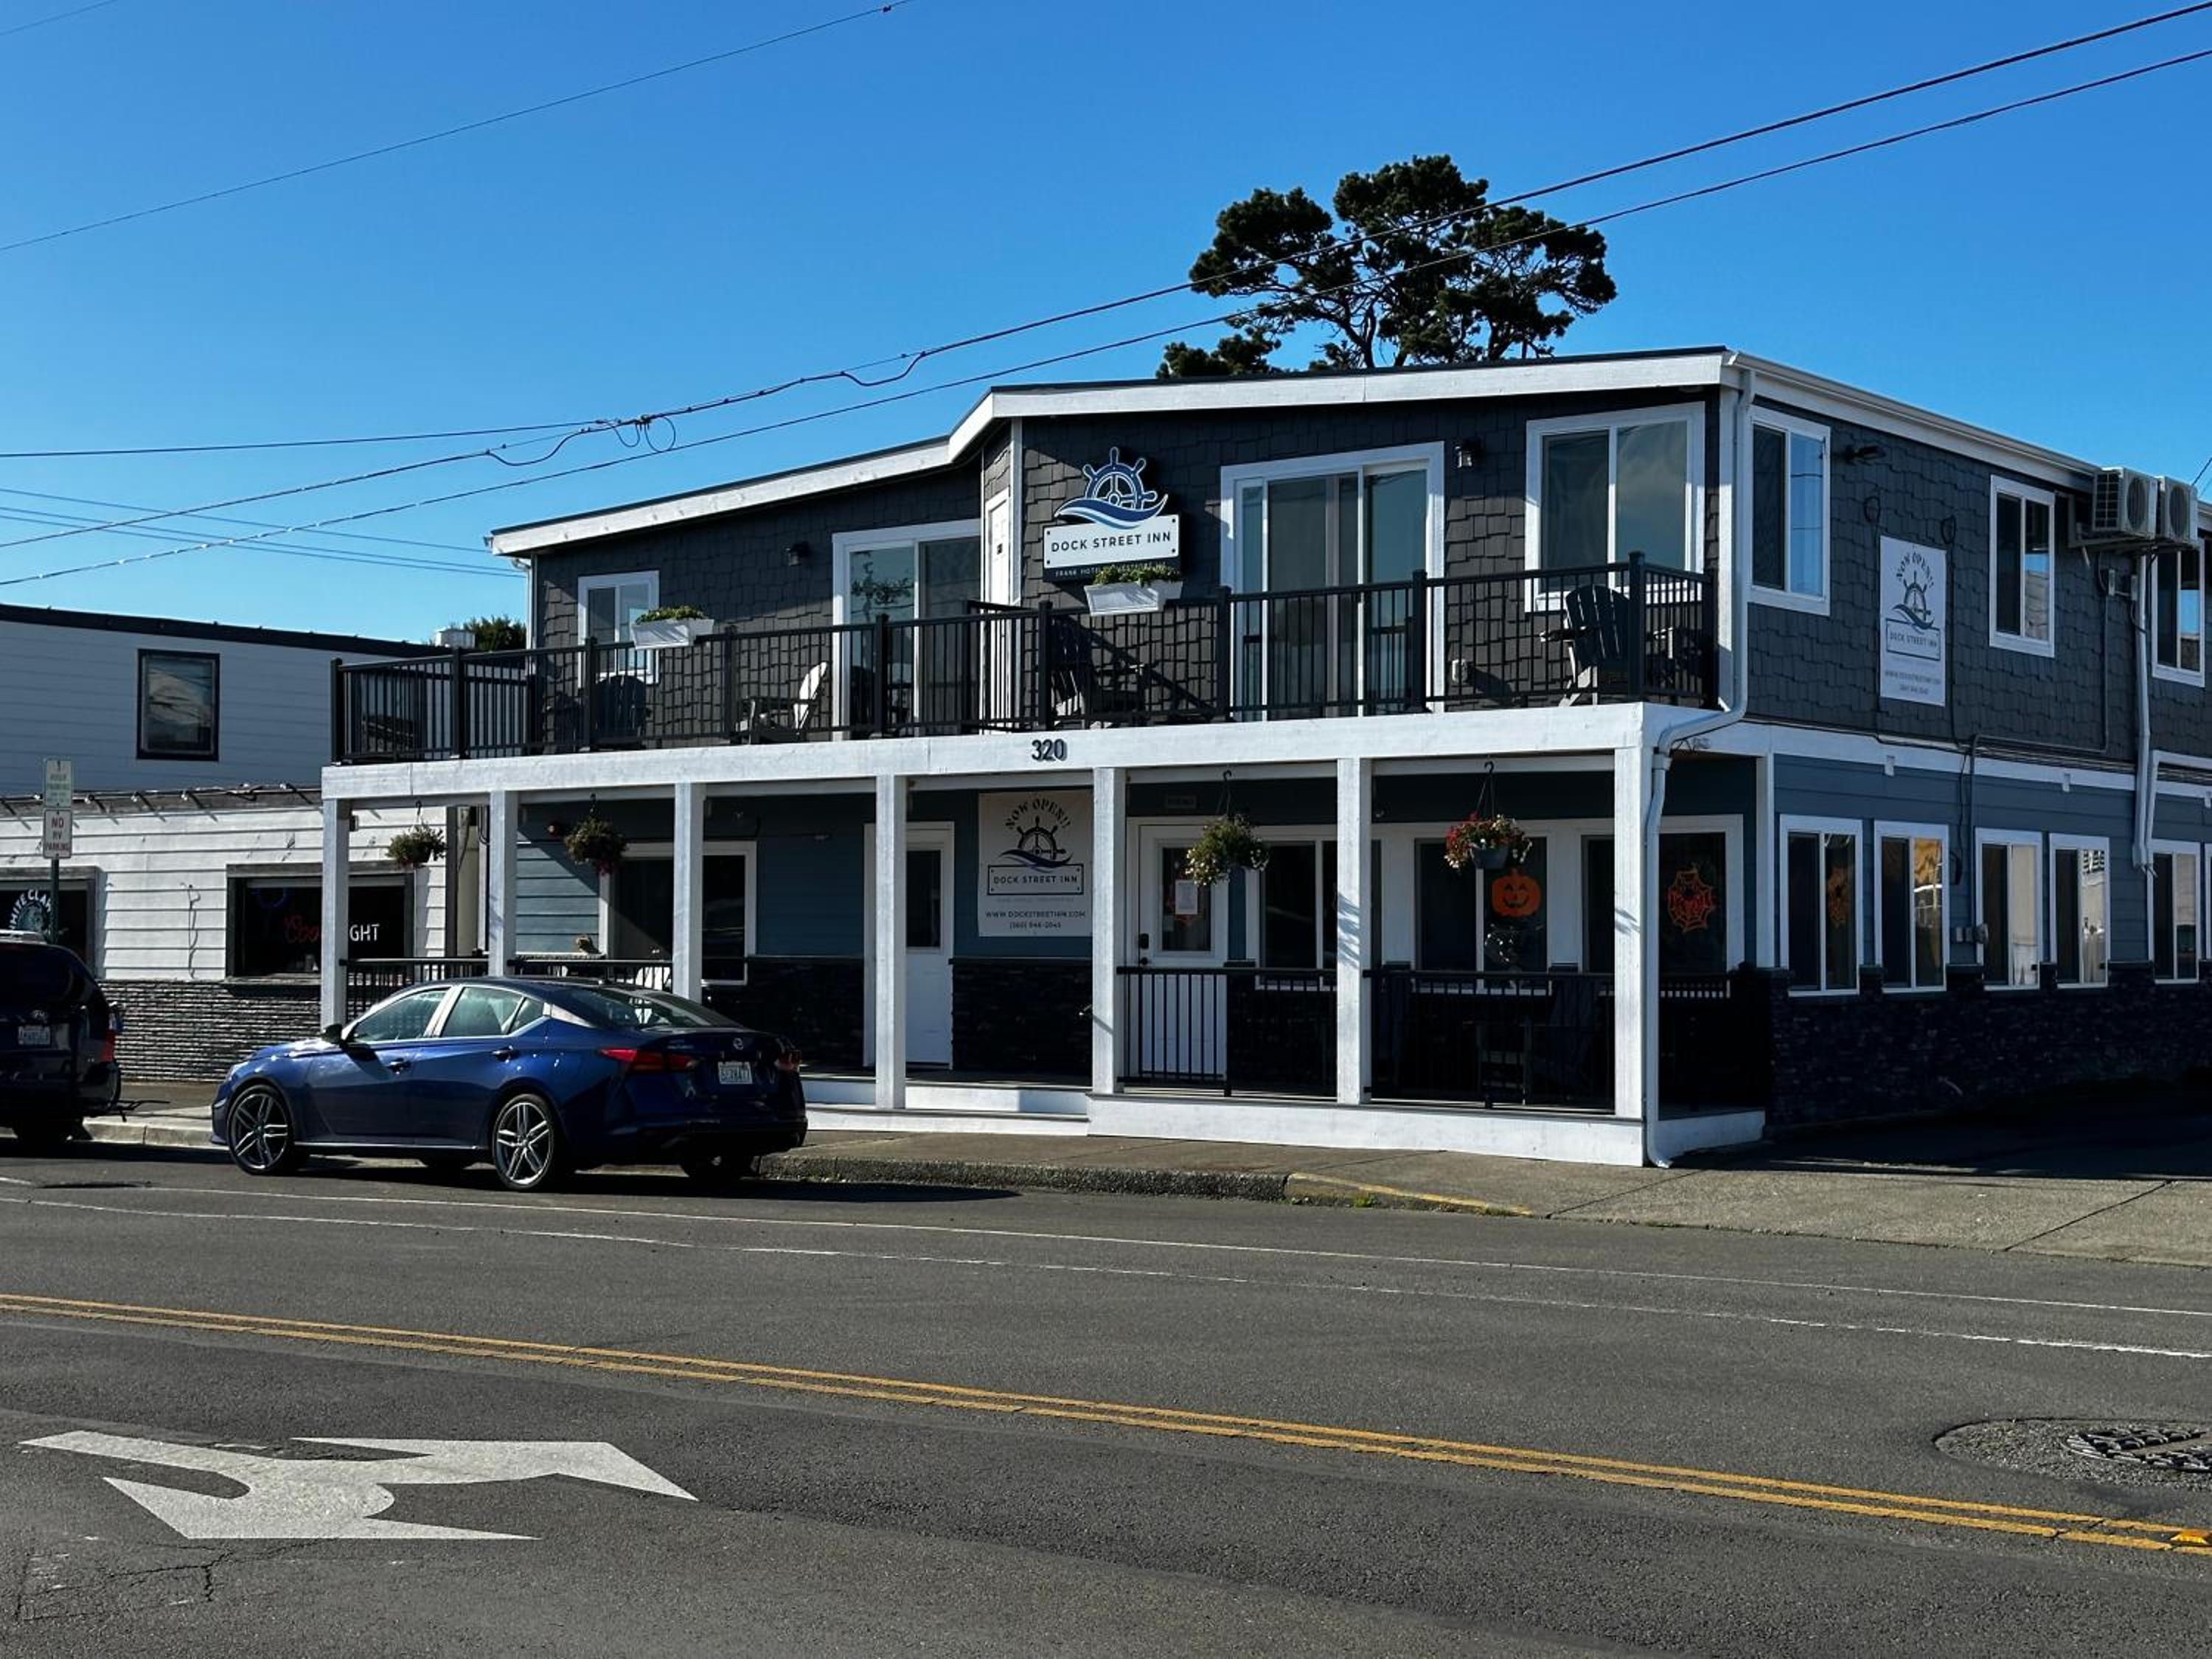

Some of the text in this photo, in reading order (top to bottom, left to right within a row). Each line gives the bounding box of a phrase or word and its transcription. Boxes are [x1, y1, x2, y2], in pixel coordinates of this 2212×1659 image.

[1051, 531, 1171, 552] DOCK STREET INN
[1032, 738, 1065, 761] 320
[52, 817, 64, 828] NO
[1005, 799, 1028, 830] NOW
[993, 875, 1077, 884] DOCK STREET INN
[349, 923, 380, 942] GHT
